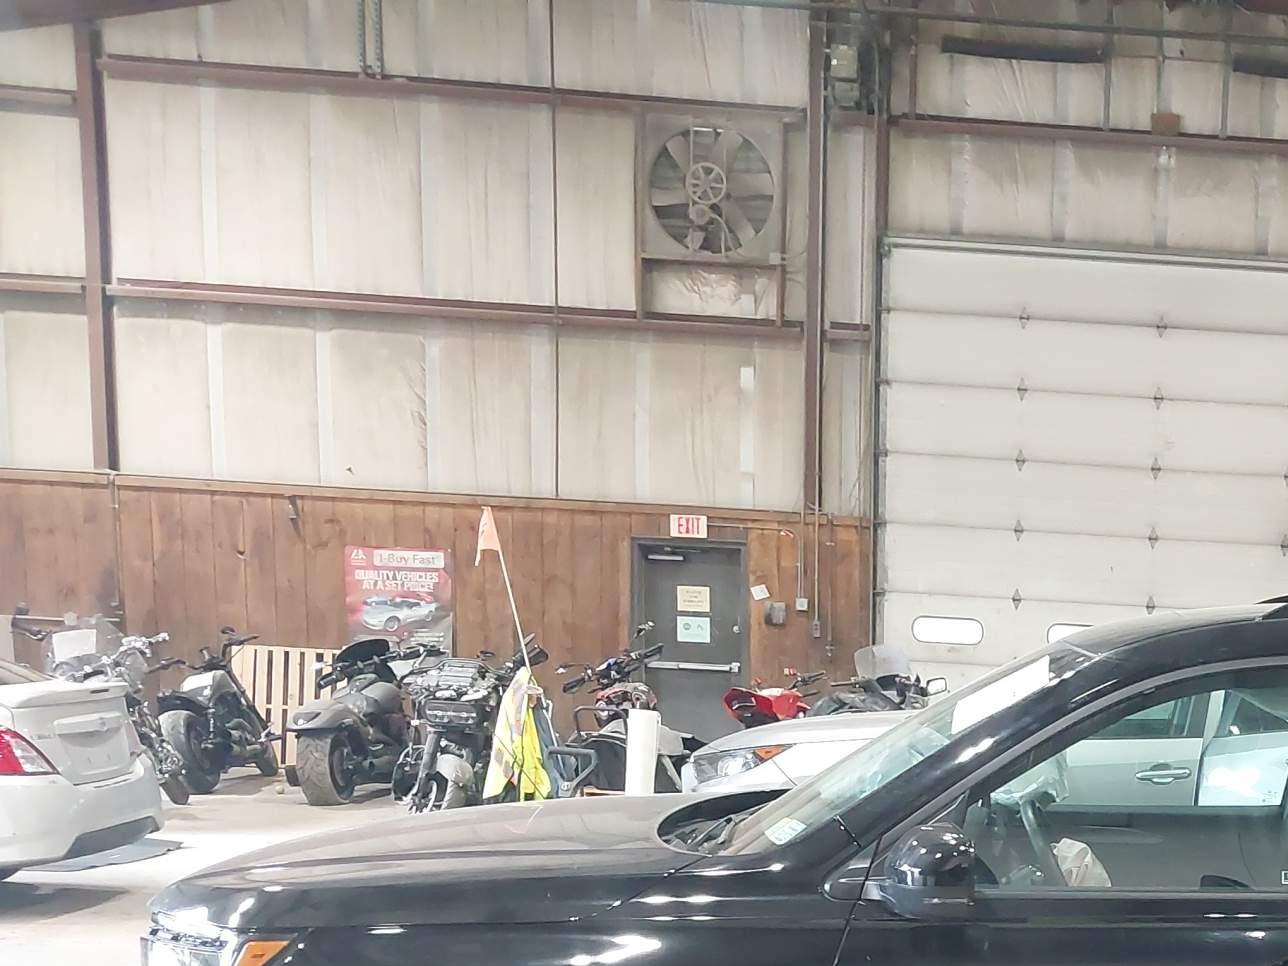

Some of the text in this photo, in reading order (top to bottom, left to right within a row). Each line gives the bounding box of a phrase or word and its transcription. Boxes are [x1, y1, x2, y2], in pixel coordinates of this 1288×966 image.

[678, 516, 701, 535] EXIT
[412, 553, 436, 566] Fast
[354, 569, 439, 583] QUALITY VEHICLES
[362, 580, 375, 590] AT
[376, 580, 384, 590] A
[385, 580, 402, 591] SET
